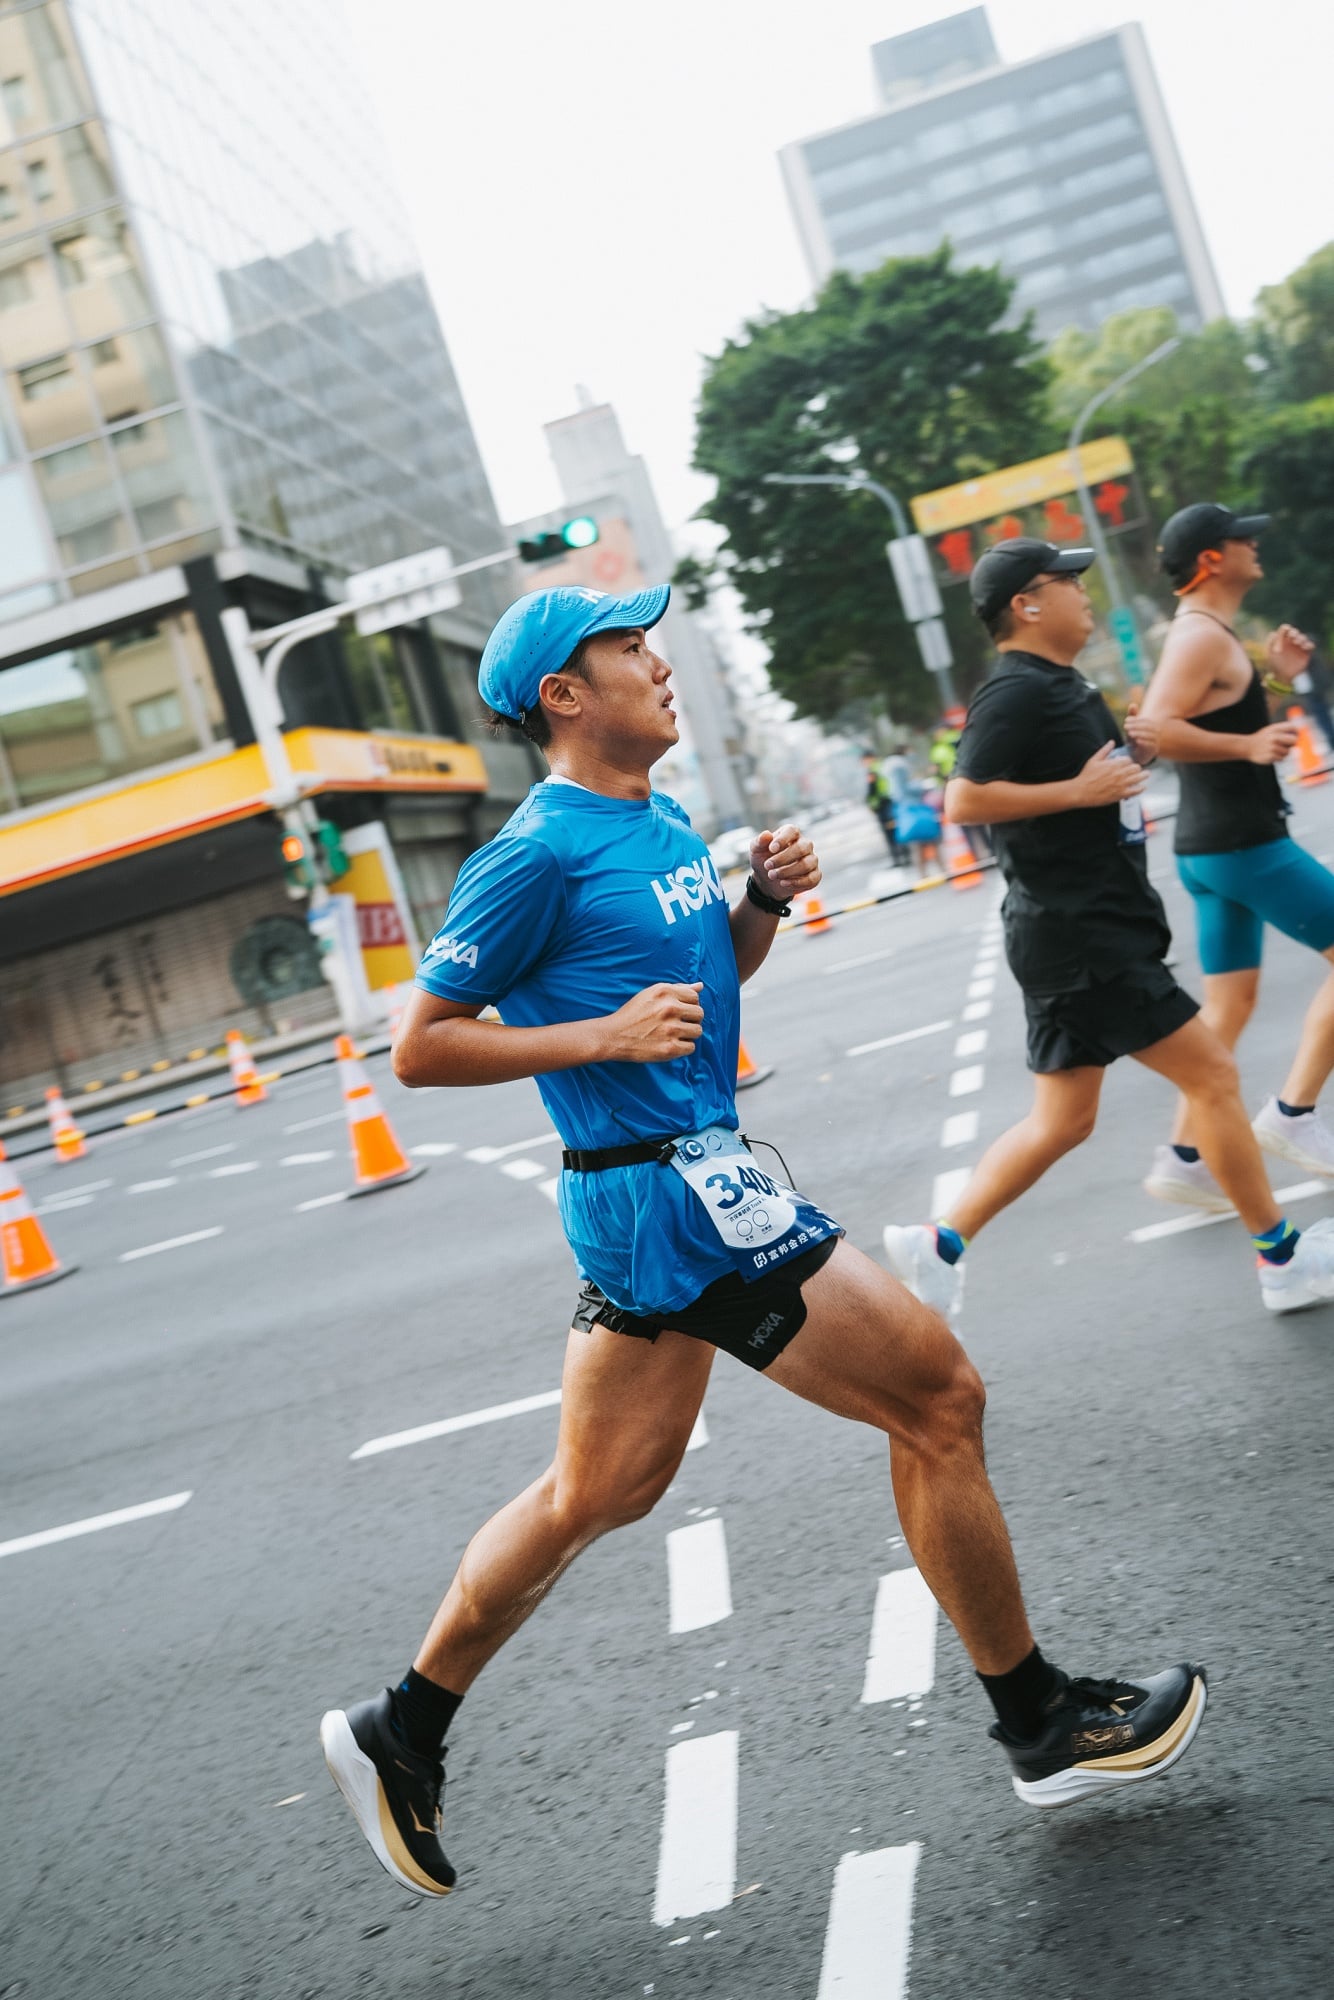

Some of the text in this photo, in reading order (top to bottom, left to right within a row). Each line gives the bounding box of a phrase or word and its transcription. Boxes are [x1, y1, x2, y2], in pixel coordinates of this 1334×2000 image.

[767, 1232, 809, 1261] 富邦金控
[747, 1312, 785, 1349] HOKA
